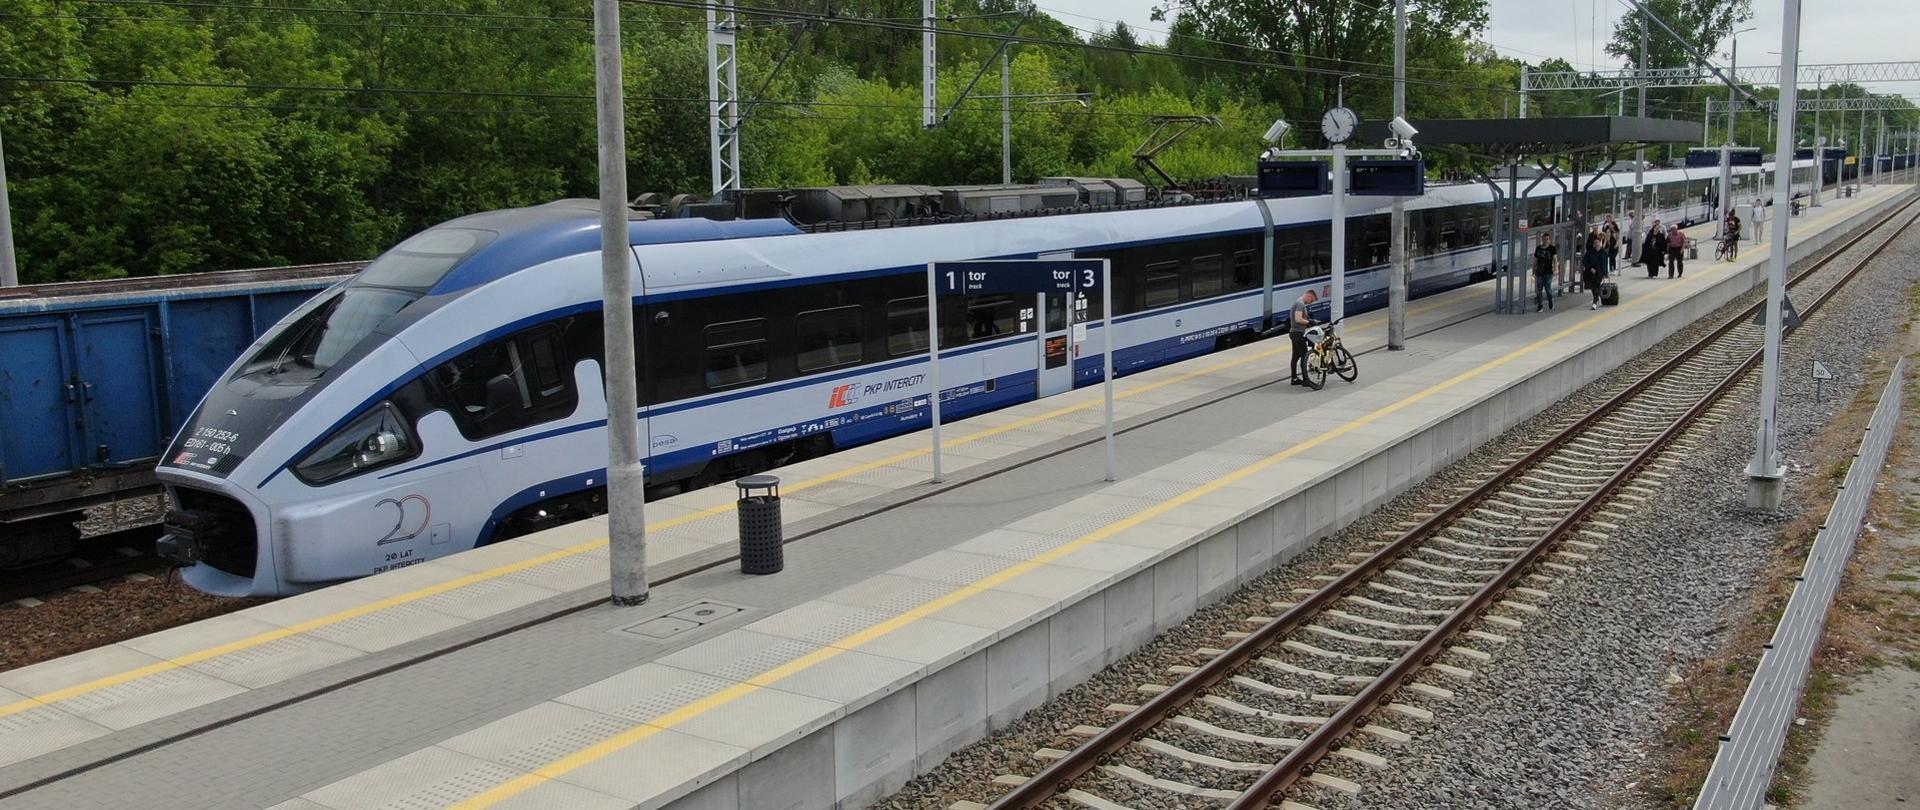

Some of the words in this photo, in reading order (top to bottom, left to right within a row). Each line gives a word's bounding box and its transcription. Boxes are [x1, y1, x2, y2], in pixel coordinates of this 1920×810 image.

[946, 271, 955, 290] 1
[968, 270, 987, 281] tor
[1052, 269, 1071, 280] tor
[1082, 269, 1095, 288] 3
[863, 382, 882, 396] PKP
[883, 373, 926, 392] INTERCITY
[202, 428, 216, 438] 150
[214, 430, 239, 443] 252-6
[209, 442, 226, 453] 005
[223, 447, 231, 455] h
[652, 438, 677, 449] pesa
[375, 494, 431, 546] 20
[400, 549, 413, 559] LAT
[373, 565, 388, 575] PKP
[390, 557, 425, 571] INTERCITY
